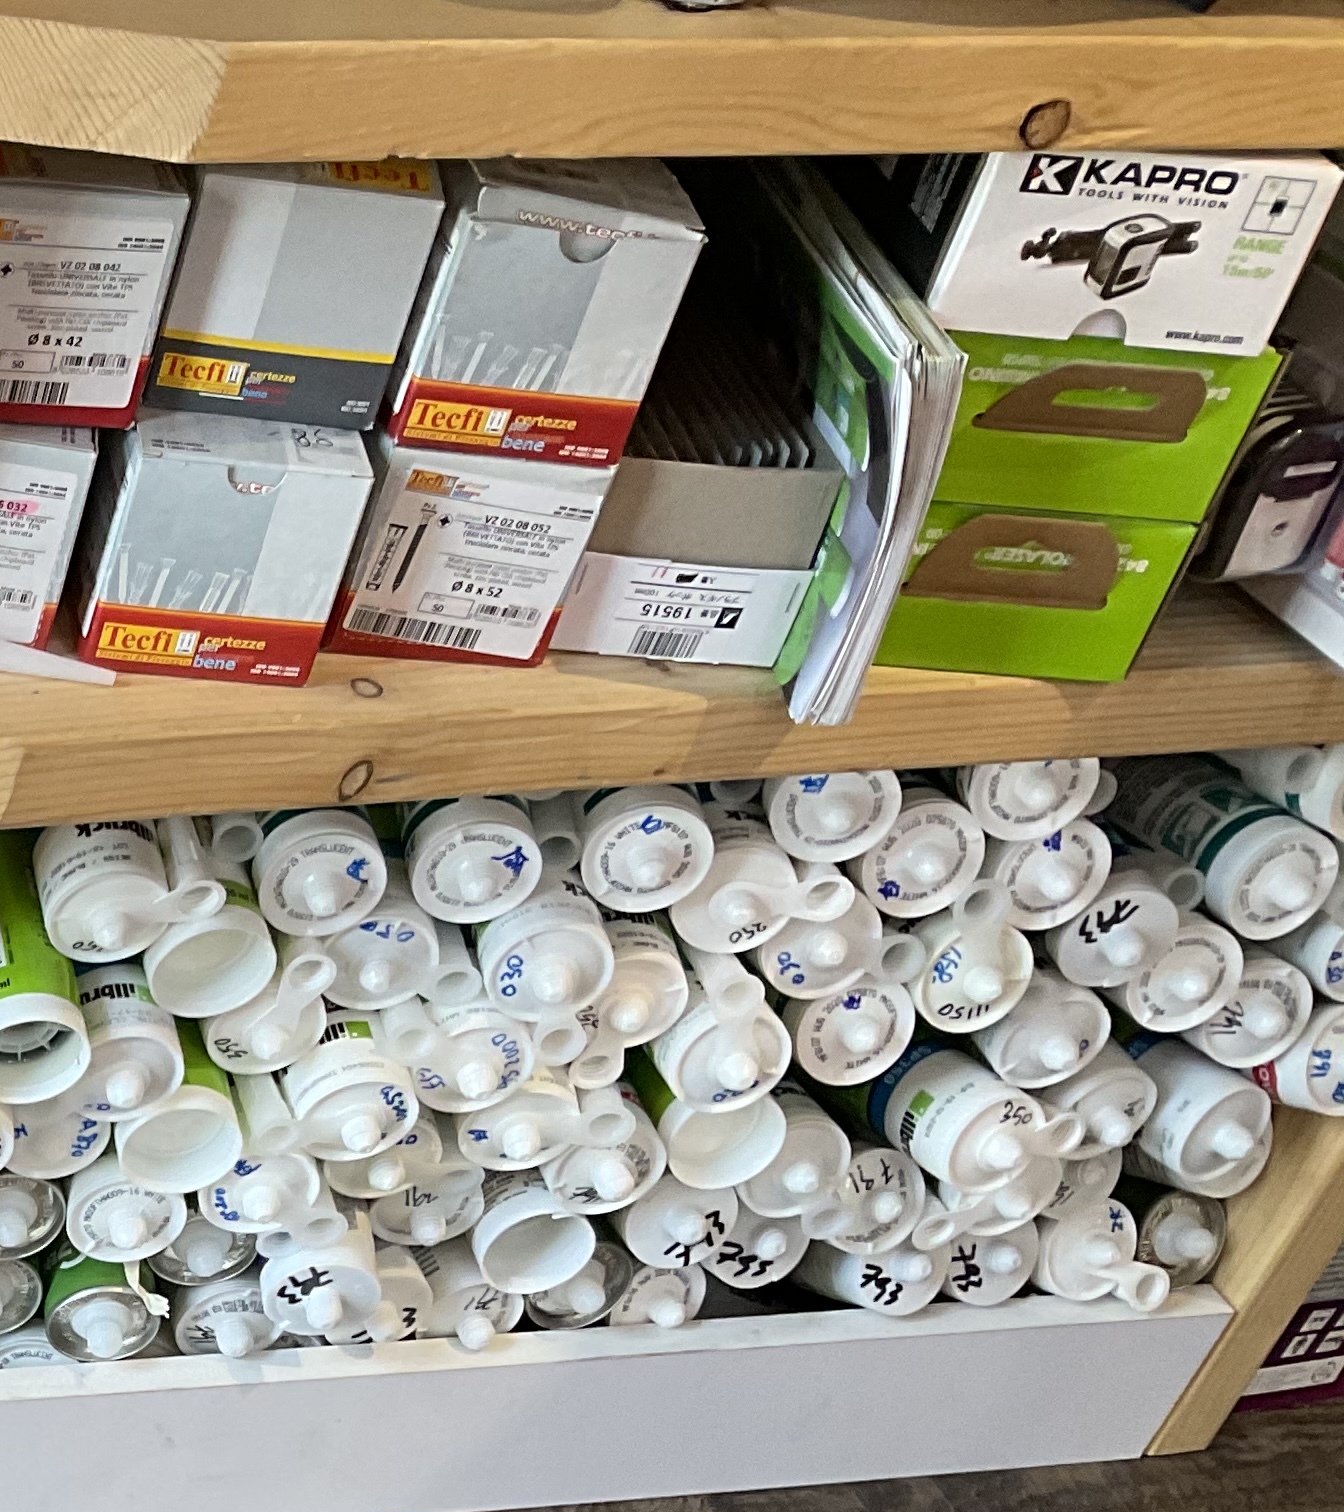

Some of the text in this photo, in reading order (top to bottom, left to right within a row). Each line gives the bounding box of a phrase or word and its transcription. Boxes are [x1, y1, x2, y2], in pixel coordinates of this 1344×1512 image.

[1082, 158, 1240, 196] KAPRO
[1077, 187, 1230, 209] TOOLS WITH VISION
[74, 262, 87, 271] 02
[42, 335, 51, 346] 8
[66, 336, 83, 348] 42
[1165, 329, 1244, 346] www.kapro.com
[11, 359, 25, 369] 50
[164, 354, 227, 383] Tecfi
[414, 402, 485, 432] Tecfi
[501, 435, 546, 452] bene
[7, 501, 28, 513] 032
[485, 515, 551, 534] VZ 02 08 052
[464, 582, 472, 593] 8
[475, 585, 484, 595] x
[485, 586, 504, 598] 52
[431, 603, 444, 613] 50
[639, 603, 694, 620] 19515
[104, 624, 173, 652] Tecfi
[192, 654, 236, 671] bene
[998, 1101, 1033, 1126] 350
